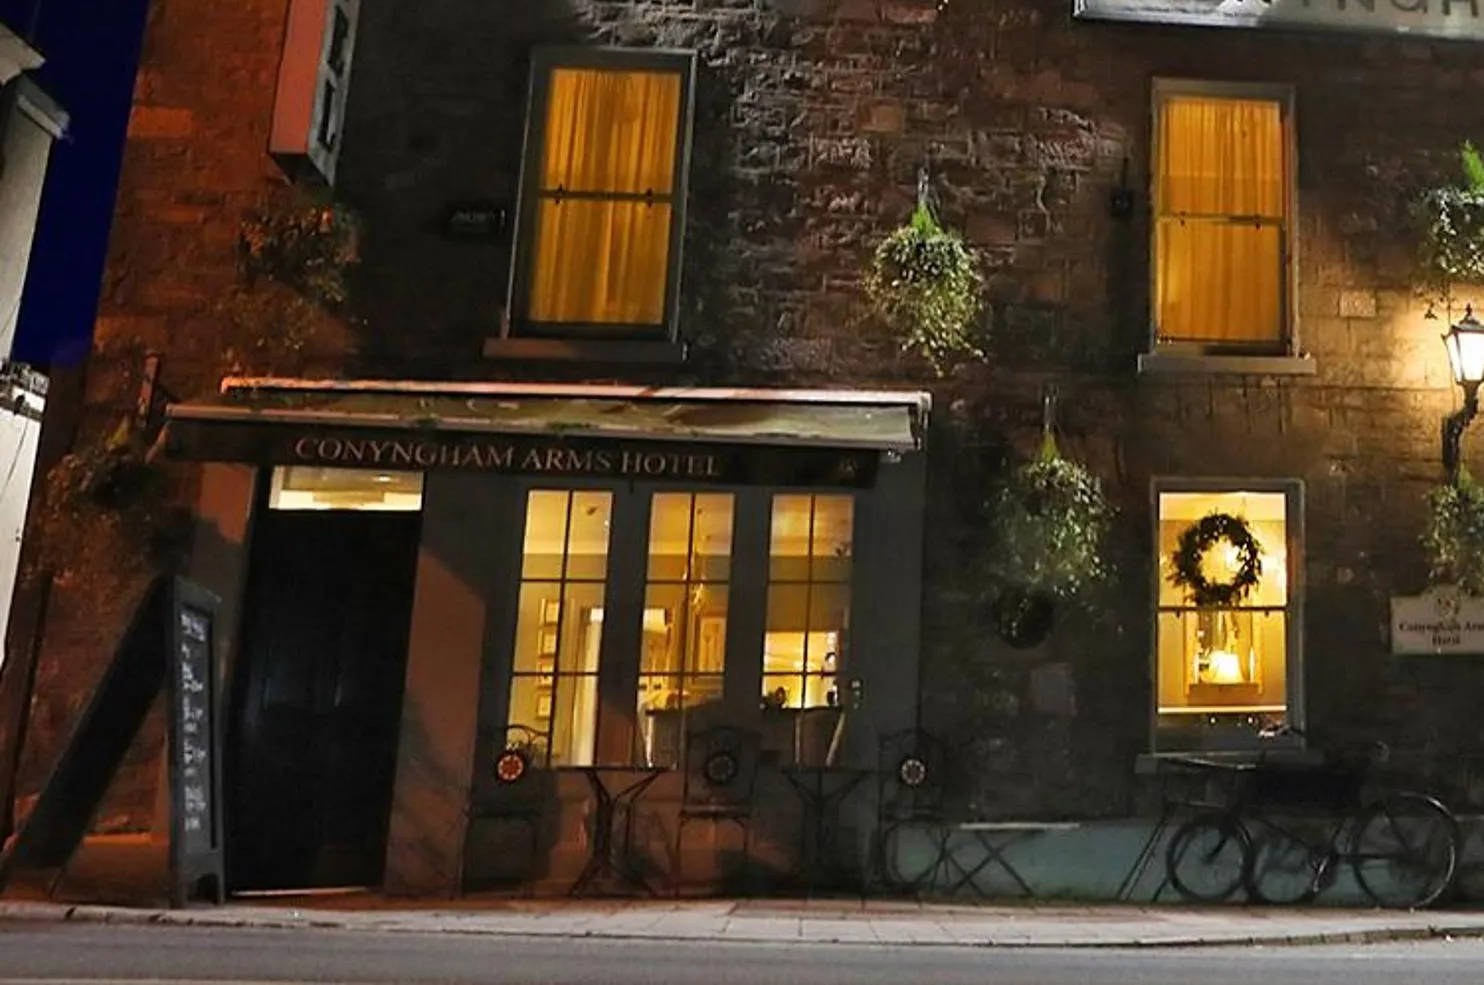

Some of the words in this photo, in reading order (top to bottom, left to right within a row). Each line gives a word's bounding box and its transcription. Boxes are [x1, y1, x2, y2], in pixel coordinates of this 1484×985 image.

[295, 437, 514, 468] CONYNGHAM
[522, 448, 611, 472] ARMS
[620, 451, 722, 477] HOTEL
[1431, 635, 1461, 647] Hotel
